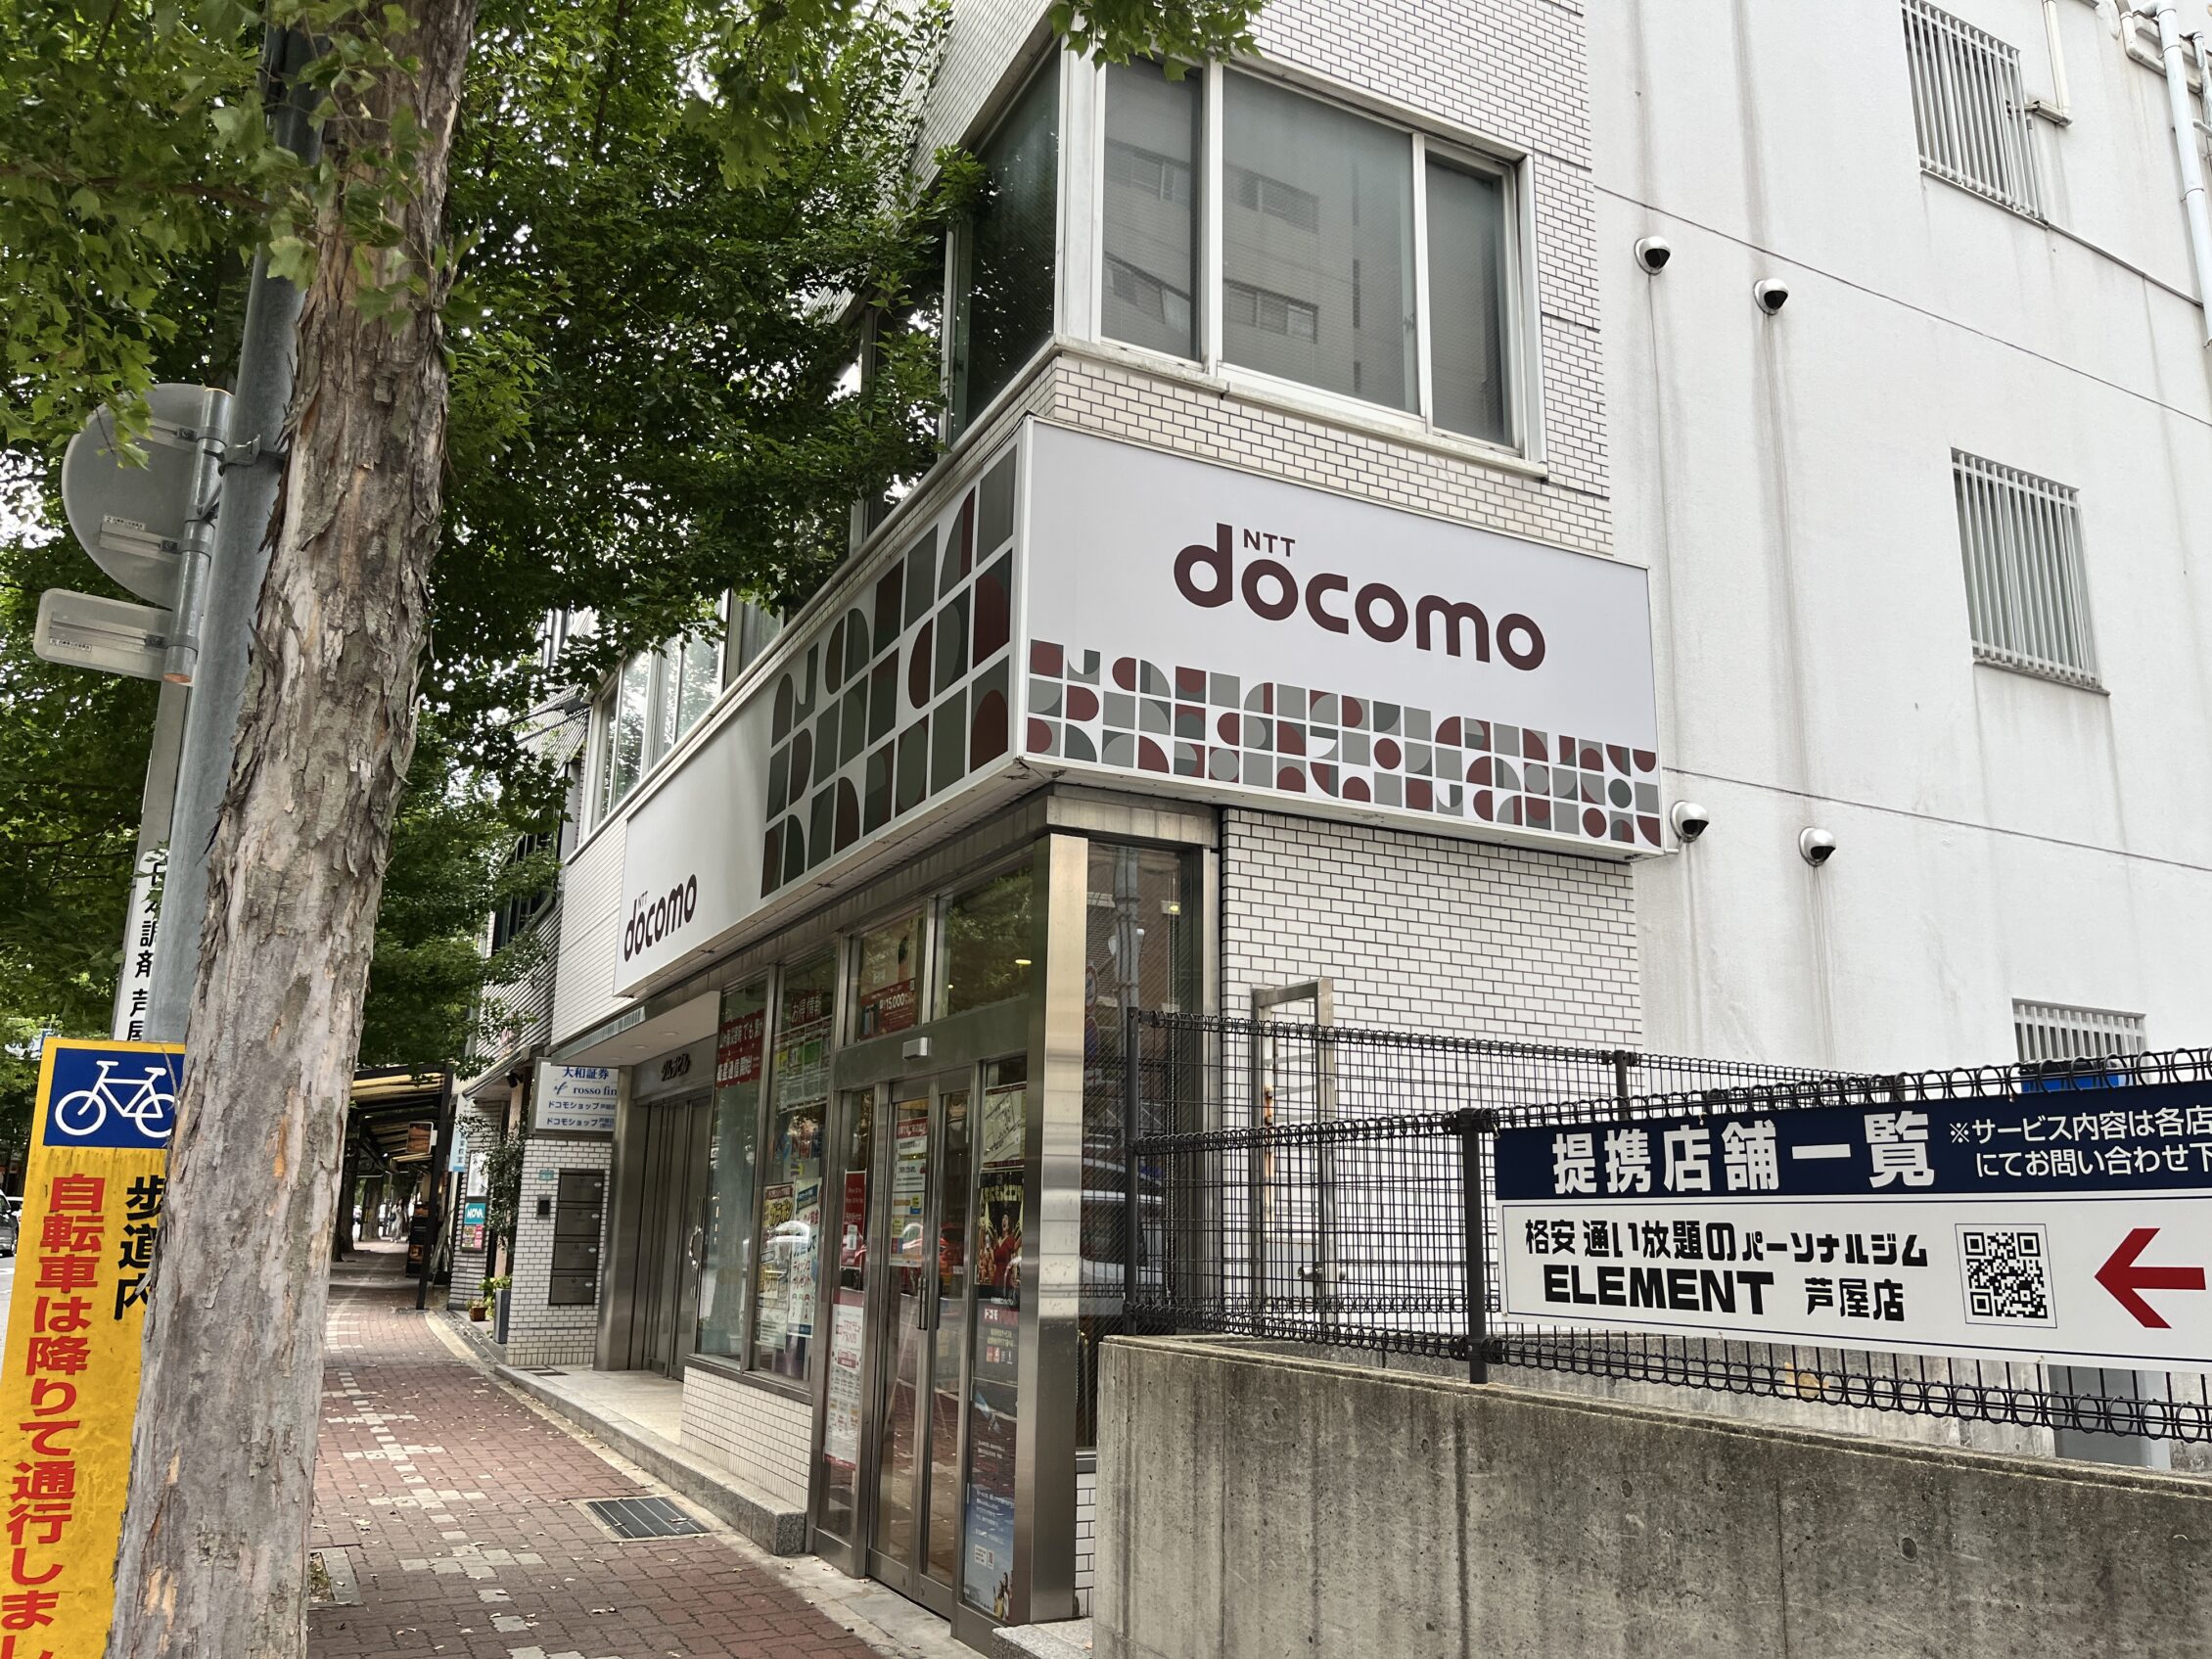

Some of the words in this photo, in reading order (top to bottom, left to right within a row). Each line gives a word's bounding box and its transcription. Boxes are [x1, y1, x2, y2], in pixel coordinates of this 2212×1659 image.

[1243, 528, 1296, 558] NTT
[1174, 523, 1545, 671] docomo
[623, 874, 698, 963] docomo
[563, 1066, 609, 1080] 大和証券
[573, 1085, 601, 1094] rosso
[1552, 1110, 1936, 1196] 提携店舗一覧
[467, 1208, 484, 1220] NOVA
[1544, 1264, 1774, 1315] ELEMENT
[1804, 1276, 1905, 1321] 芦屋店
